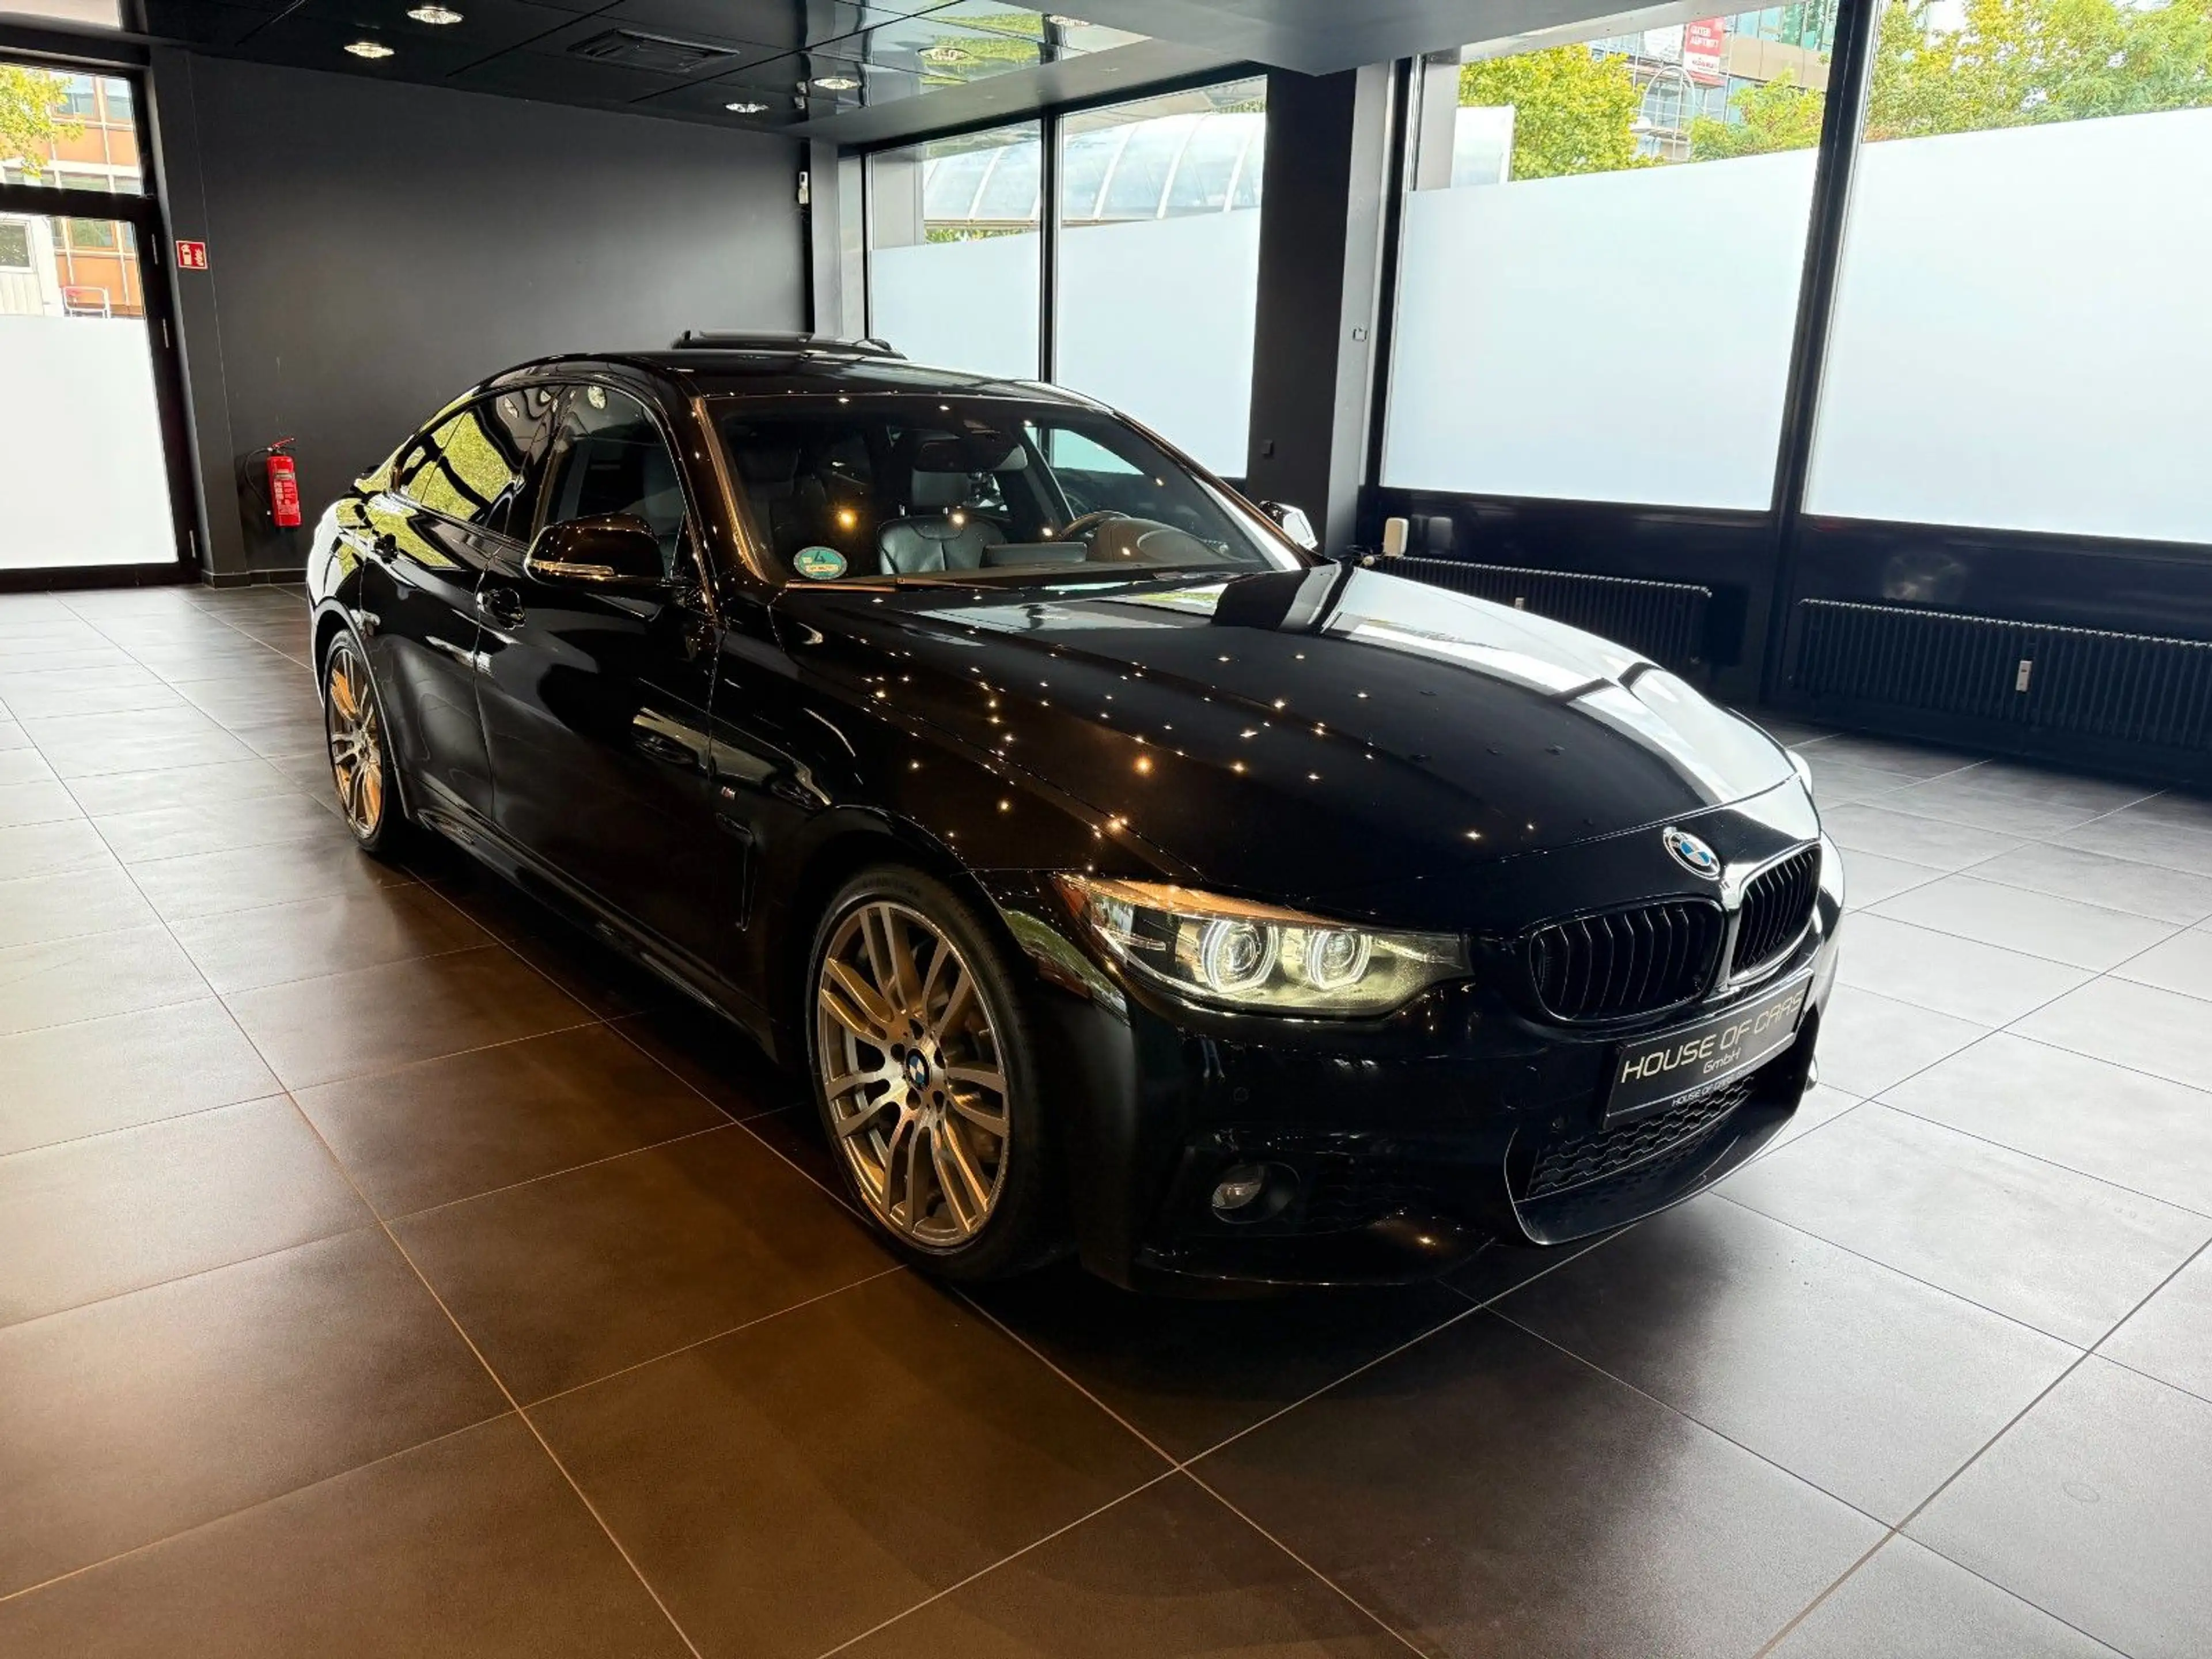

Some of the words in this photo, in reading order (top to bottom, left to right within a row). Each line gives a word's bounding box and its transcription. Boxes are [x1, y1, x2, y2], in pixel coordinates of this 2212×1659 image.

[814, 551, 826, 563] 4
[1621, 1034, 1717, 1083] HOUSE
[1719, 1018, 1752, 1050] OF
[1754, 988, 1805, 1035] CARS
[1703, 1047, 1742, 1074] GmbH
